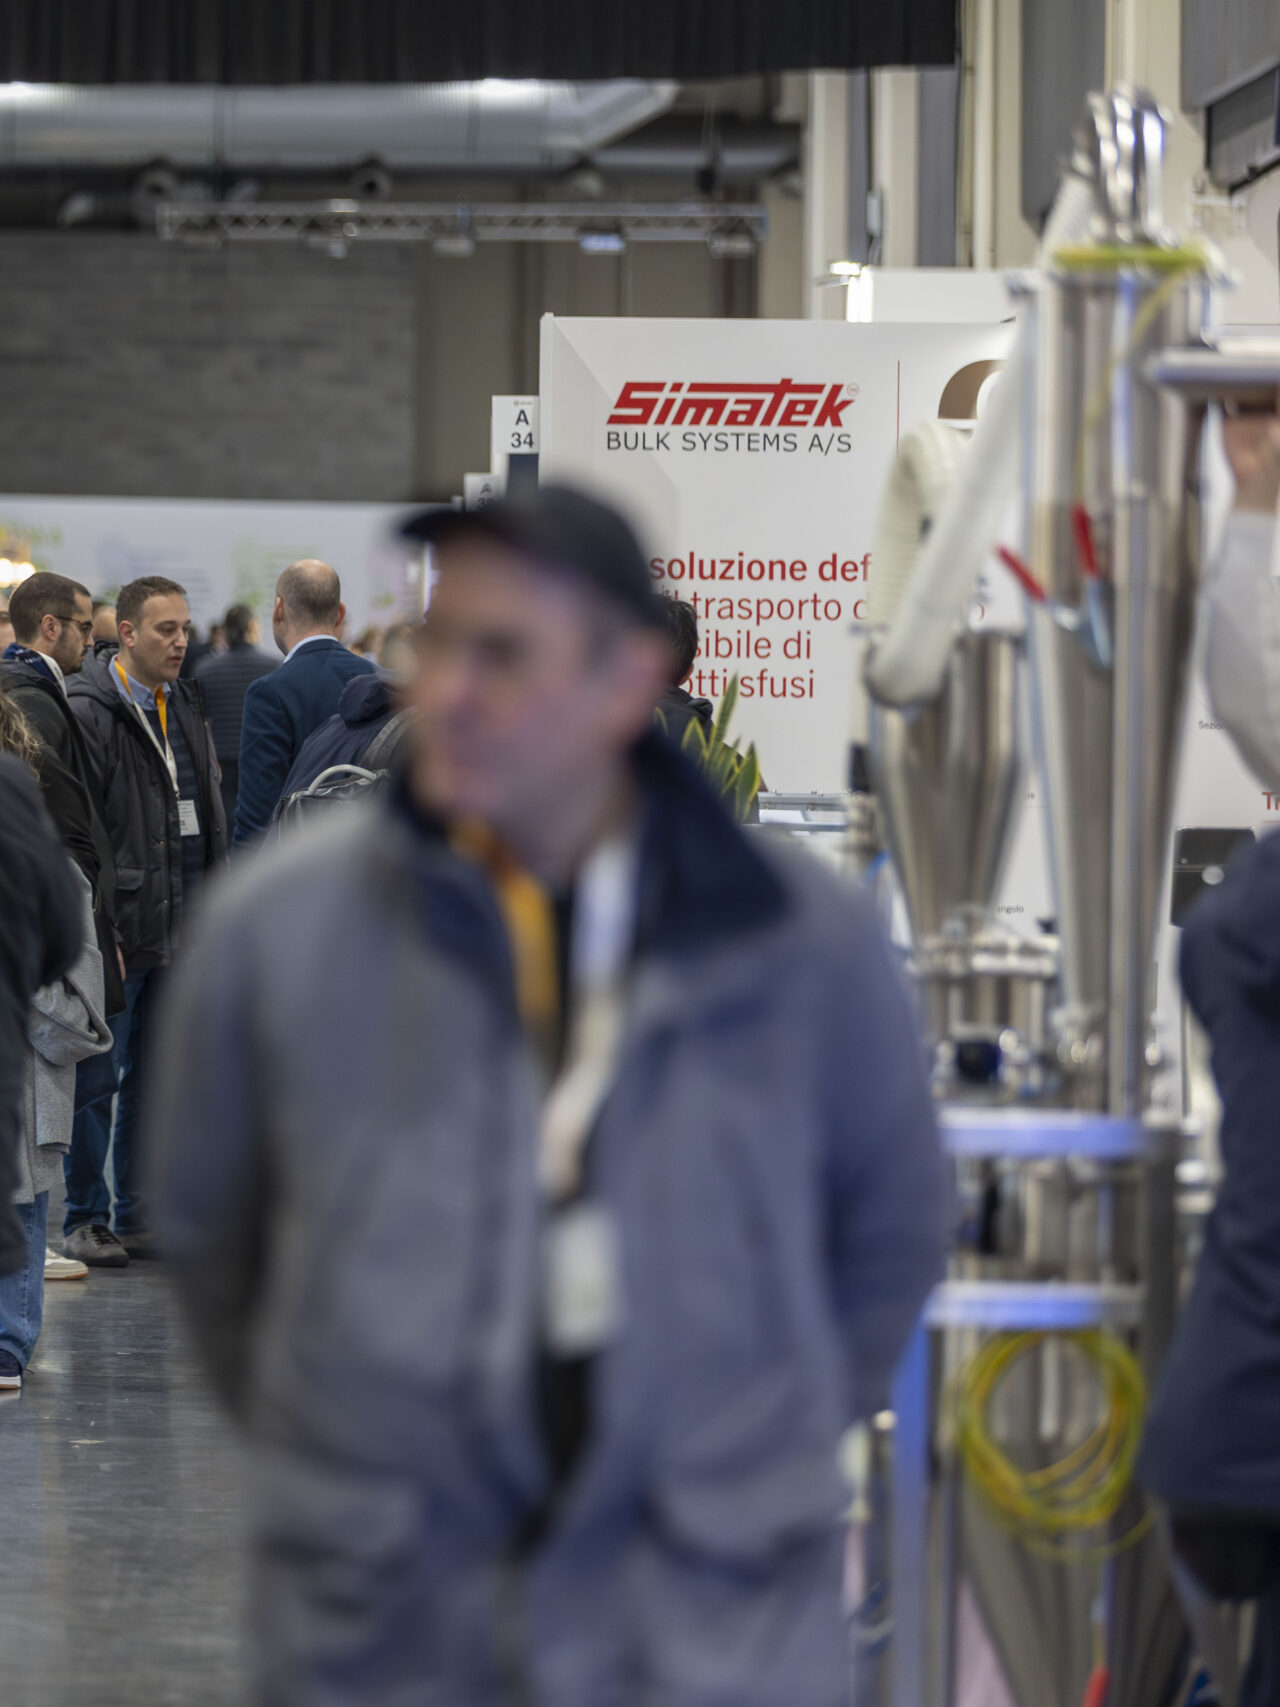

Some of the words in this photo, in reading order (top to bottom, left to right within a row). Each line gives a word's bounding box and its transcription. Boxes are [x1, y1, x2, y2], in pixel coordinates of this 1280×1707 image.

[607, 378, 855, 427] Simatek
[515, 409, 530, 426] A
[511, 432, 535, 448] 34
[607, 431, 670, 451] BULK
[682, 432, 798, 452] SYSTEMS
[808, 433, 852, 456] A/S
[649, 551, 808, 581] soluzione
[818, 553, 871, 582] def
[690, 591, 842, 626] trasporto
[783, 630, 811, 659] di
[739, 668, 814, 698] sfusi
